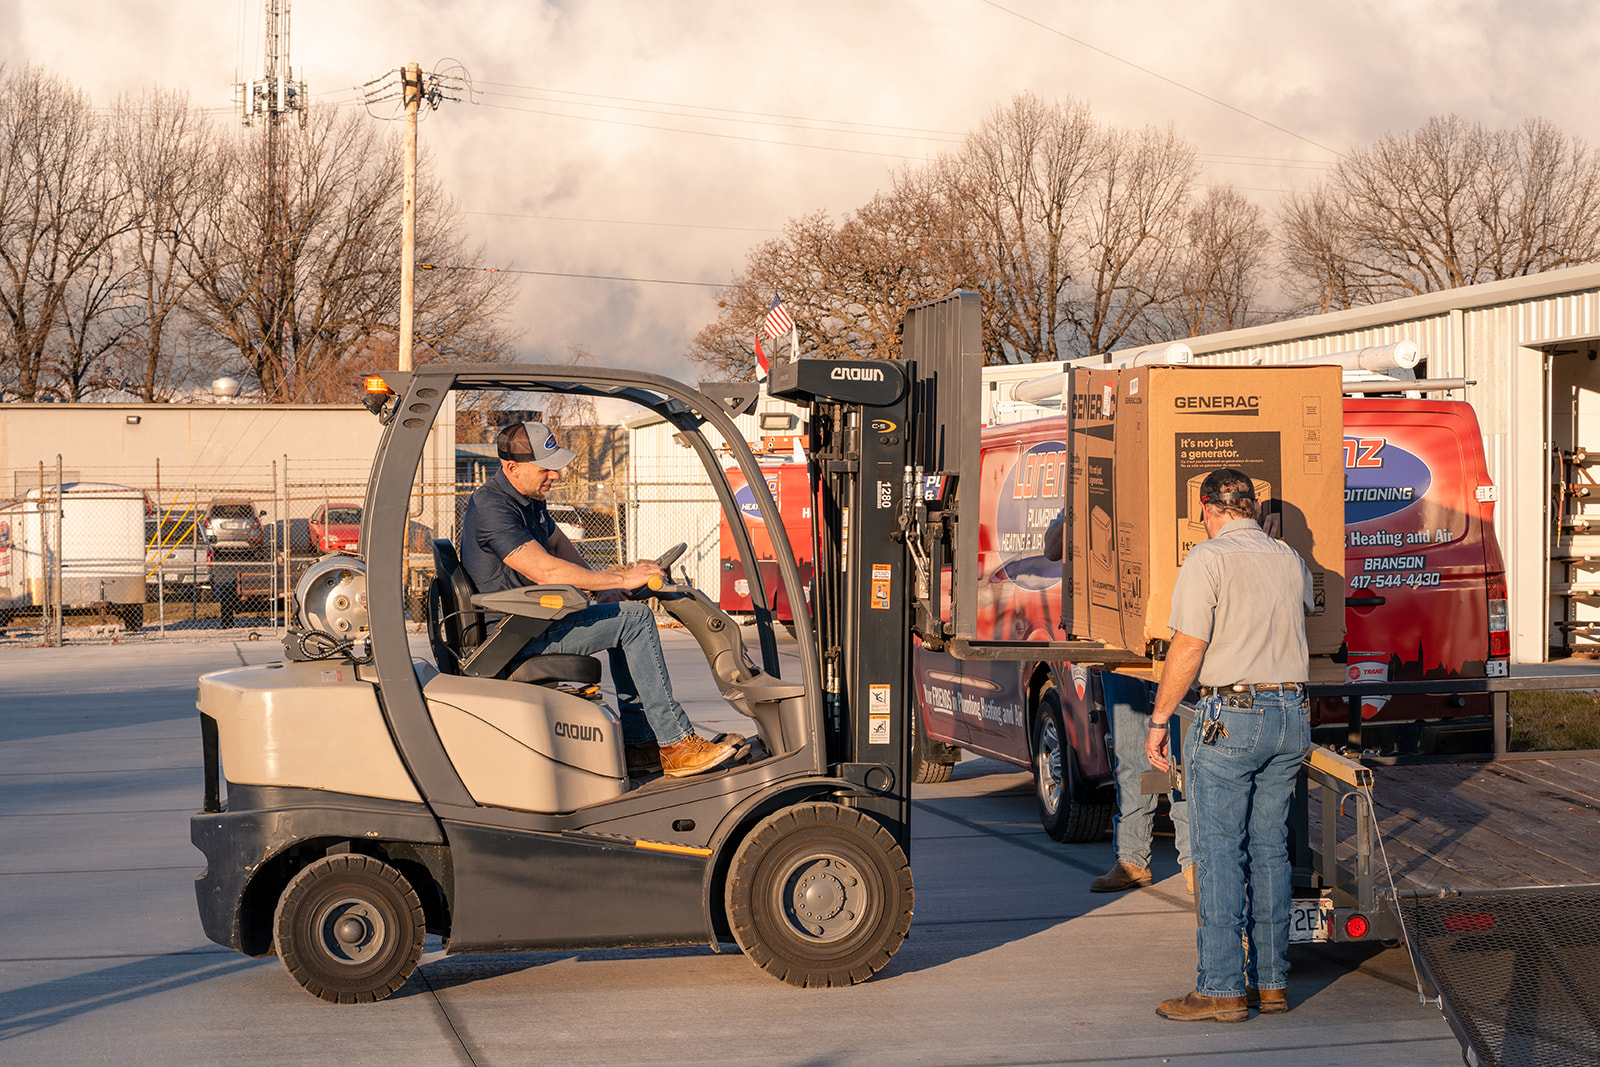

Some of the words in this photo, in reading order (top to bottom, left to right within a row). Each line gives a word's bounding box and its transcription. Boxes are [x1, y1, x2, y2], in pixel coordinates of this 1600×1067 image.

[831, 367, 884, 381] CROWN
[1072, 394, 1116, 421] GENERC
[1175, 396, 1259, 408] GENERAC
[1180, 438, 1196, 448] It's
[1197, 439, 1214, 448] not
[1214, 438, 1234, 450] just
[1188, 449, 1239, 460] generator.
[881, 481, 892, 508] 1280
[1350, 530, 1403, 546] Heating
[1406, 529, 1431, 544] and
[1434, 528, 1454, 543] Air
[1363, 556, 1425, 571] BRANSON
[1350, 573, 1441, 589] 417-544-4430
[554, 721, 604, 743] CROWN
